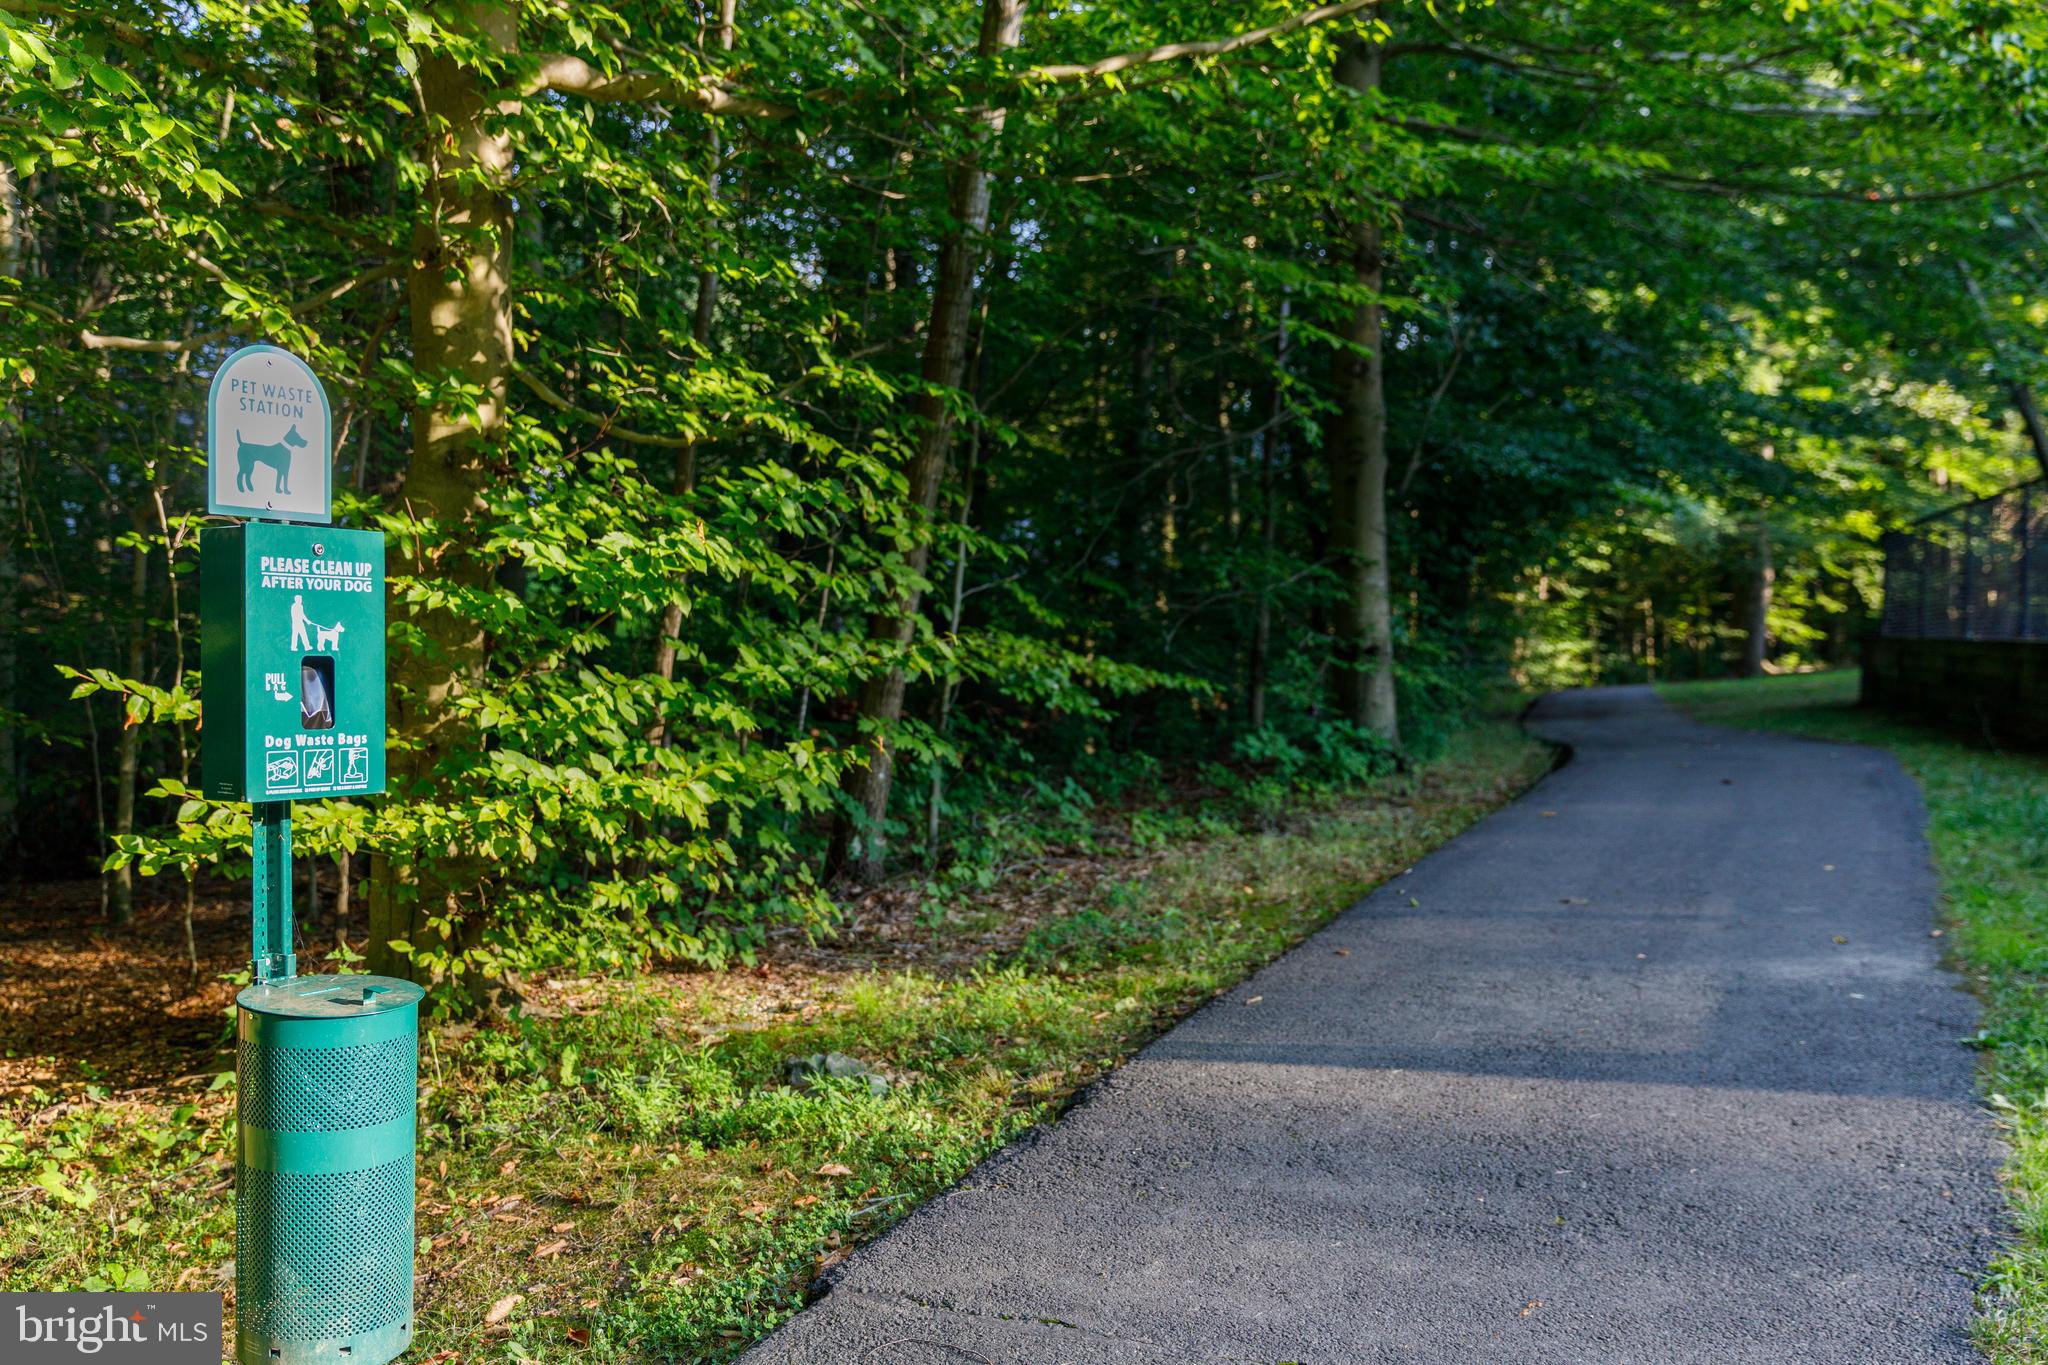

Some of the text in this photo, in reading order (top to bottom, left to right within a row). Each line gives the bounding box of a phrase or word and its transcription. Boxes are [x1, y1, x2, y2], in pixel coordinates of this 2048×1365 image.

[231, 379, 312, 403] PET WASTE
[240, 397, 303, 418] STATION
[261, 556, 372, 576] PLEASE CLEAN UP
[262, 575, 372, 592] AFTER YOUR DOG
[265, 673, 286, 684] PULL
[265, 732, 367, 749] Dog Waste Bags
